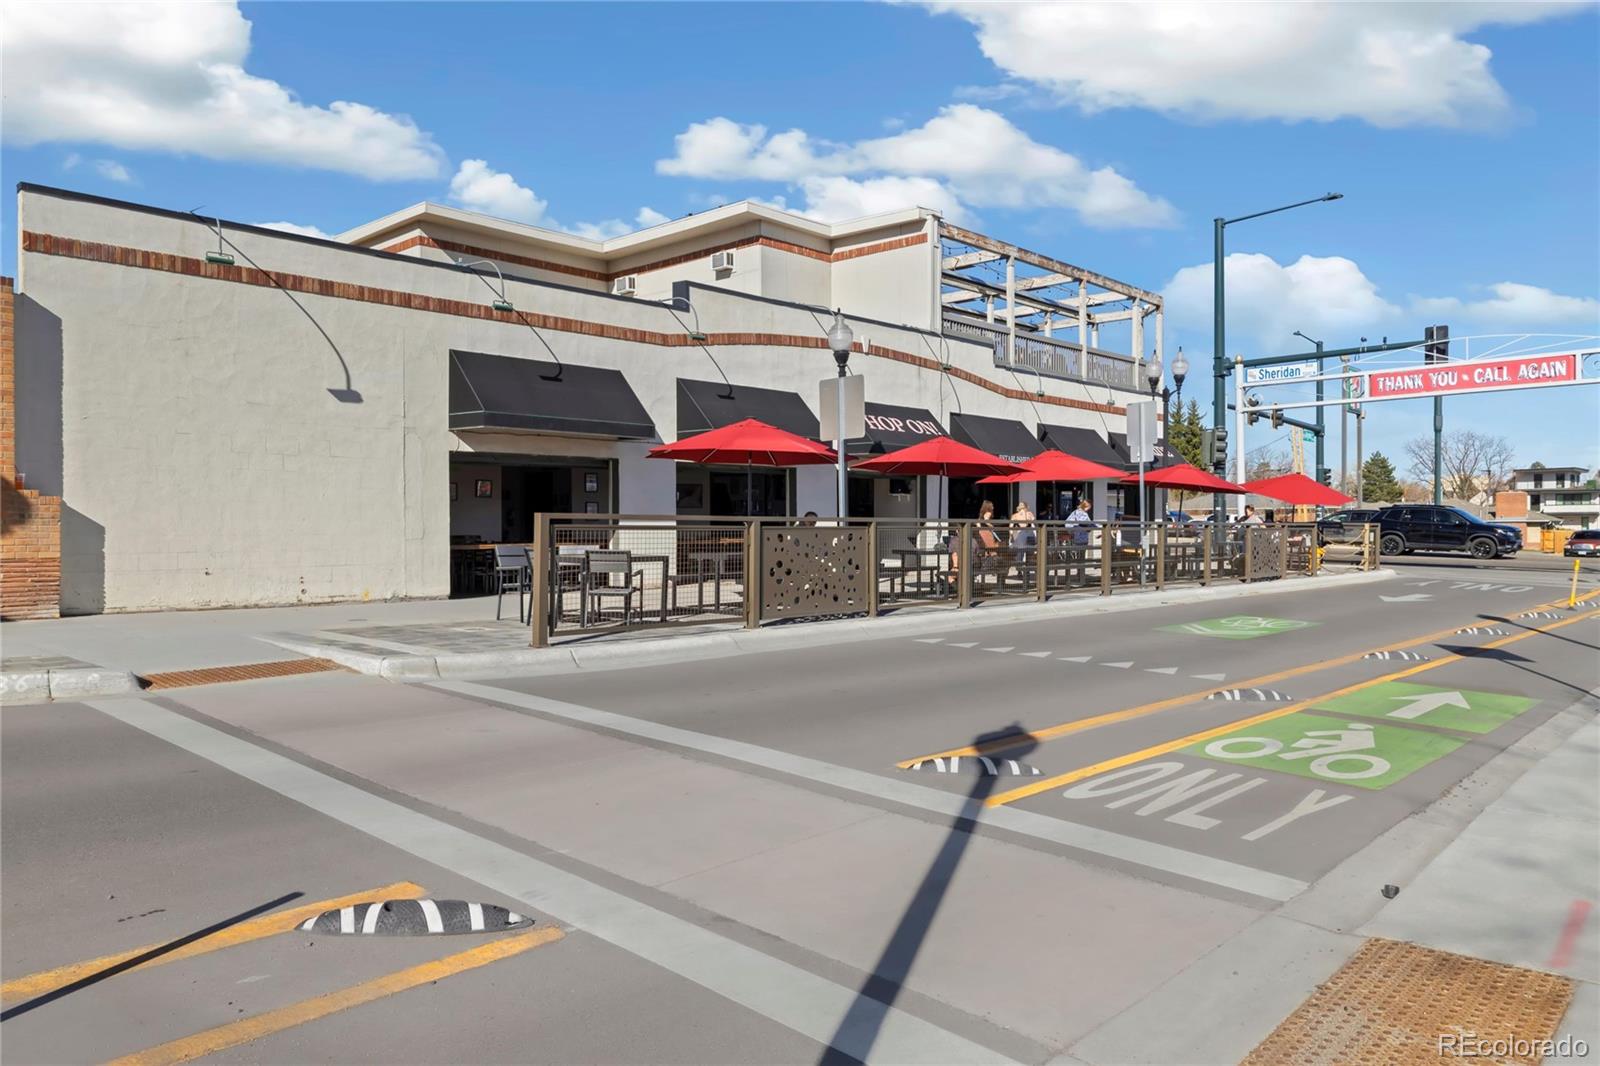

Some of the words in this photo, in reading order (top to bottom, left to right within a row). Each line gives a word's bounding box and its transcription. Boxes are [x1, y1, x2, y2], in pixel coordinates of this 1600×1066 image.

[1258, 366, 1301, 380] Sheridan
[1376, 374, 1423, 392] THANK
[1429, 371, 1458, 387] YOU
[1473, 366, 1512, 384] CALL
[1517, 359, 1567, 380] AGAIN
[905, 418, 942, 436] ON!
[1062, 761, 1355, 841] ONLY
